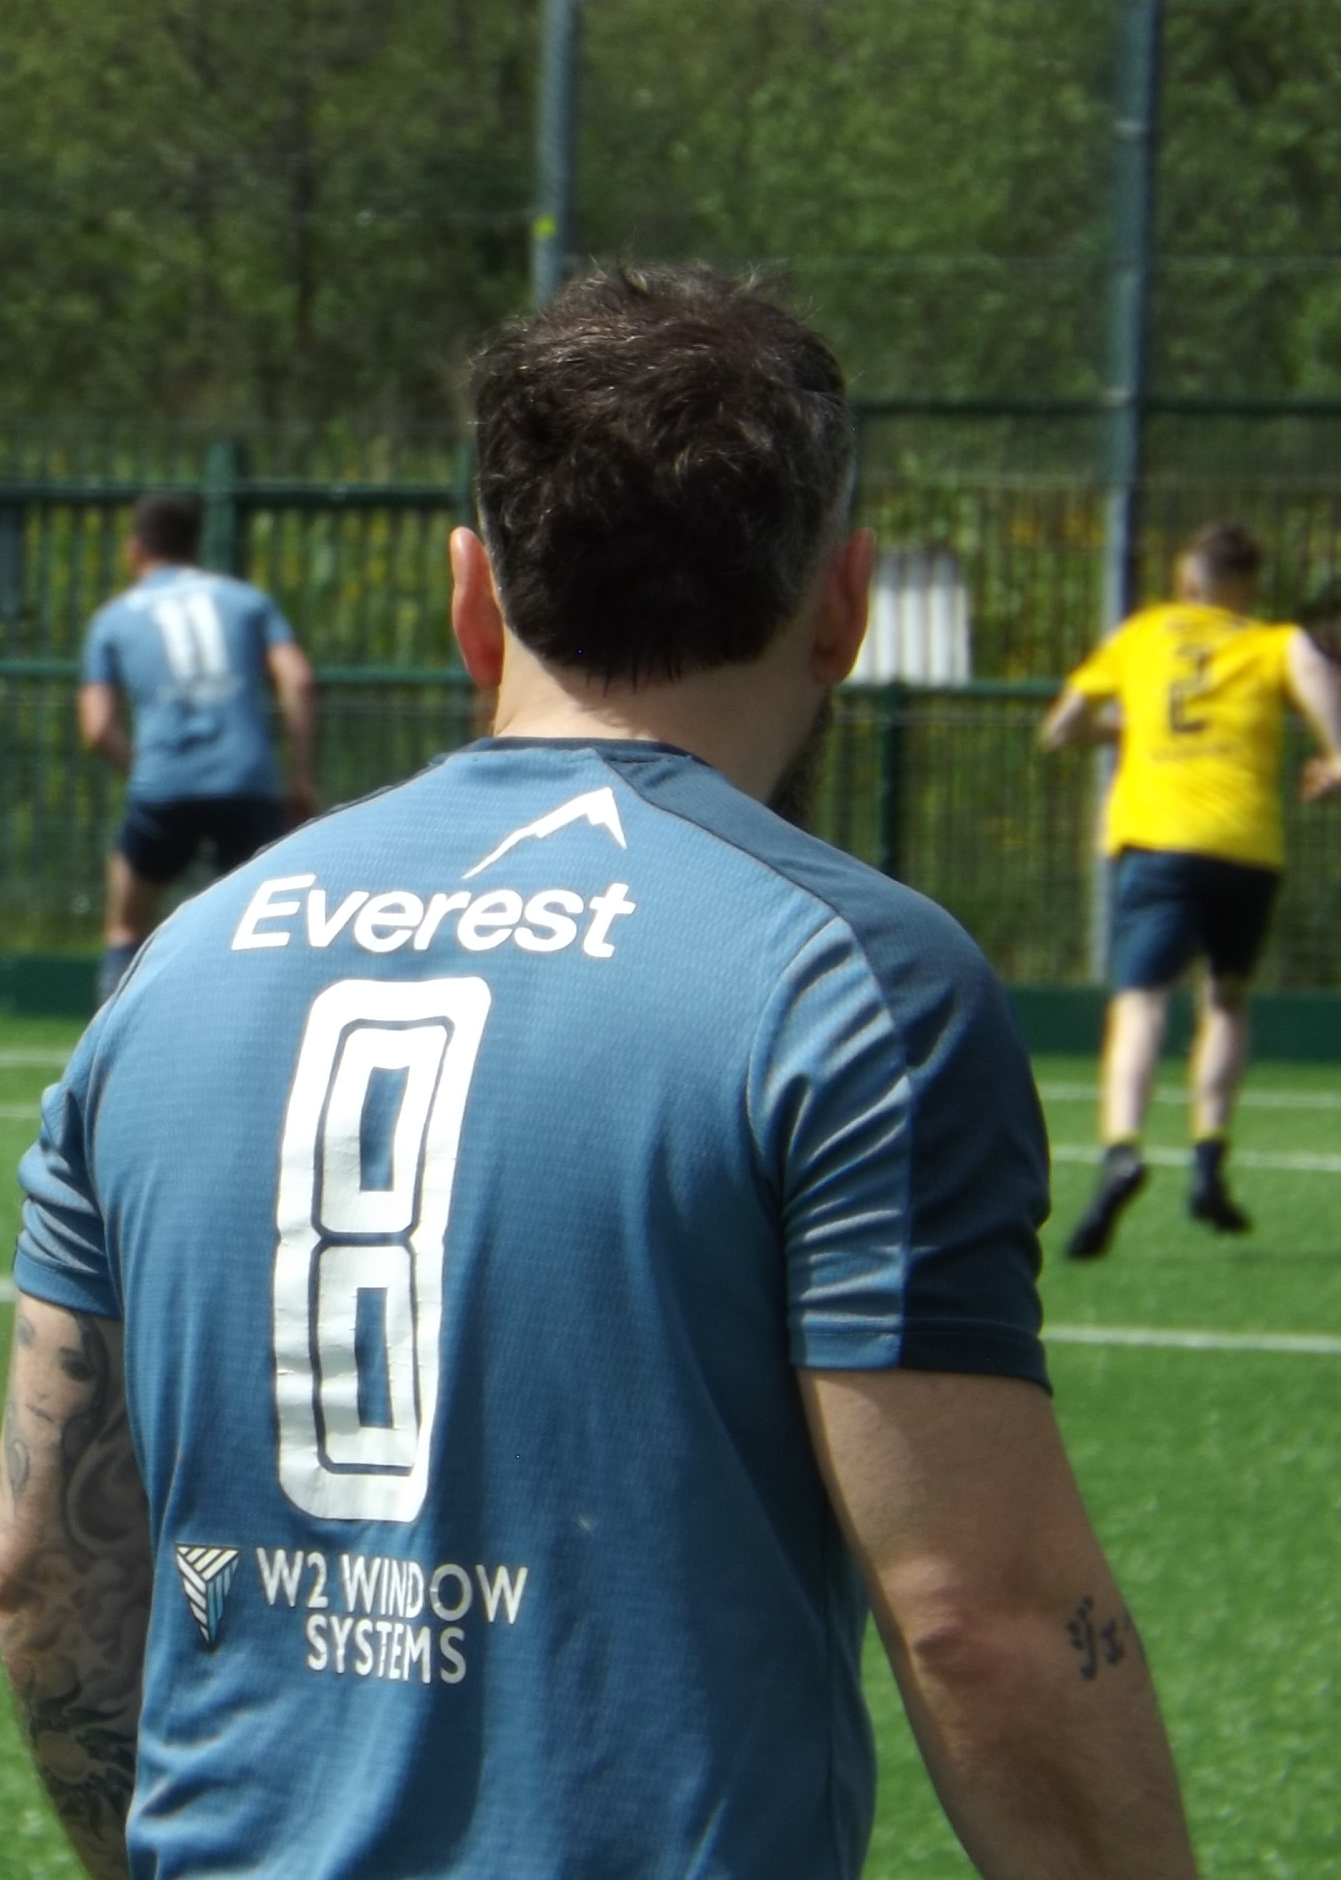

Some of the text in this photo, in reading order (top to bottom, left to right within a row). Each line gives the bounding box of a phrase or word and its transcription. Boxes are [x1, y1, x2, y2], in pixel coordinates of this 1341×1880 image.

[231, 874, 636, 958] Everest
[273, 977, 491, 1522] 8
[256, 1547, 528, 1624] W2 WINDOW
[305, 1614, 466, 1684] SYSTEMS
